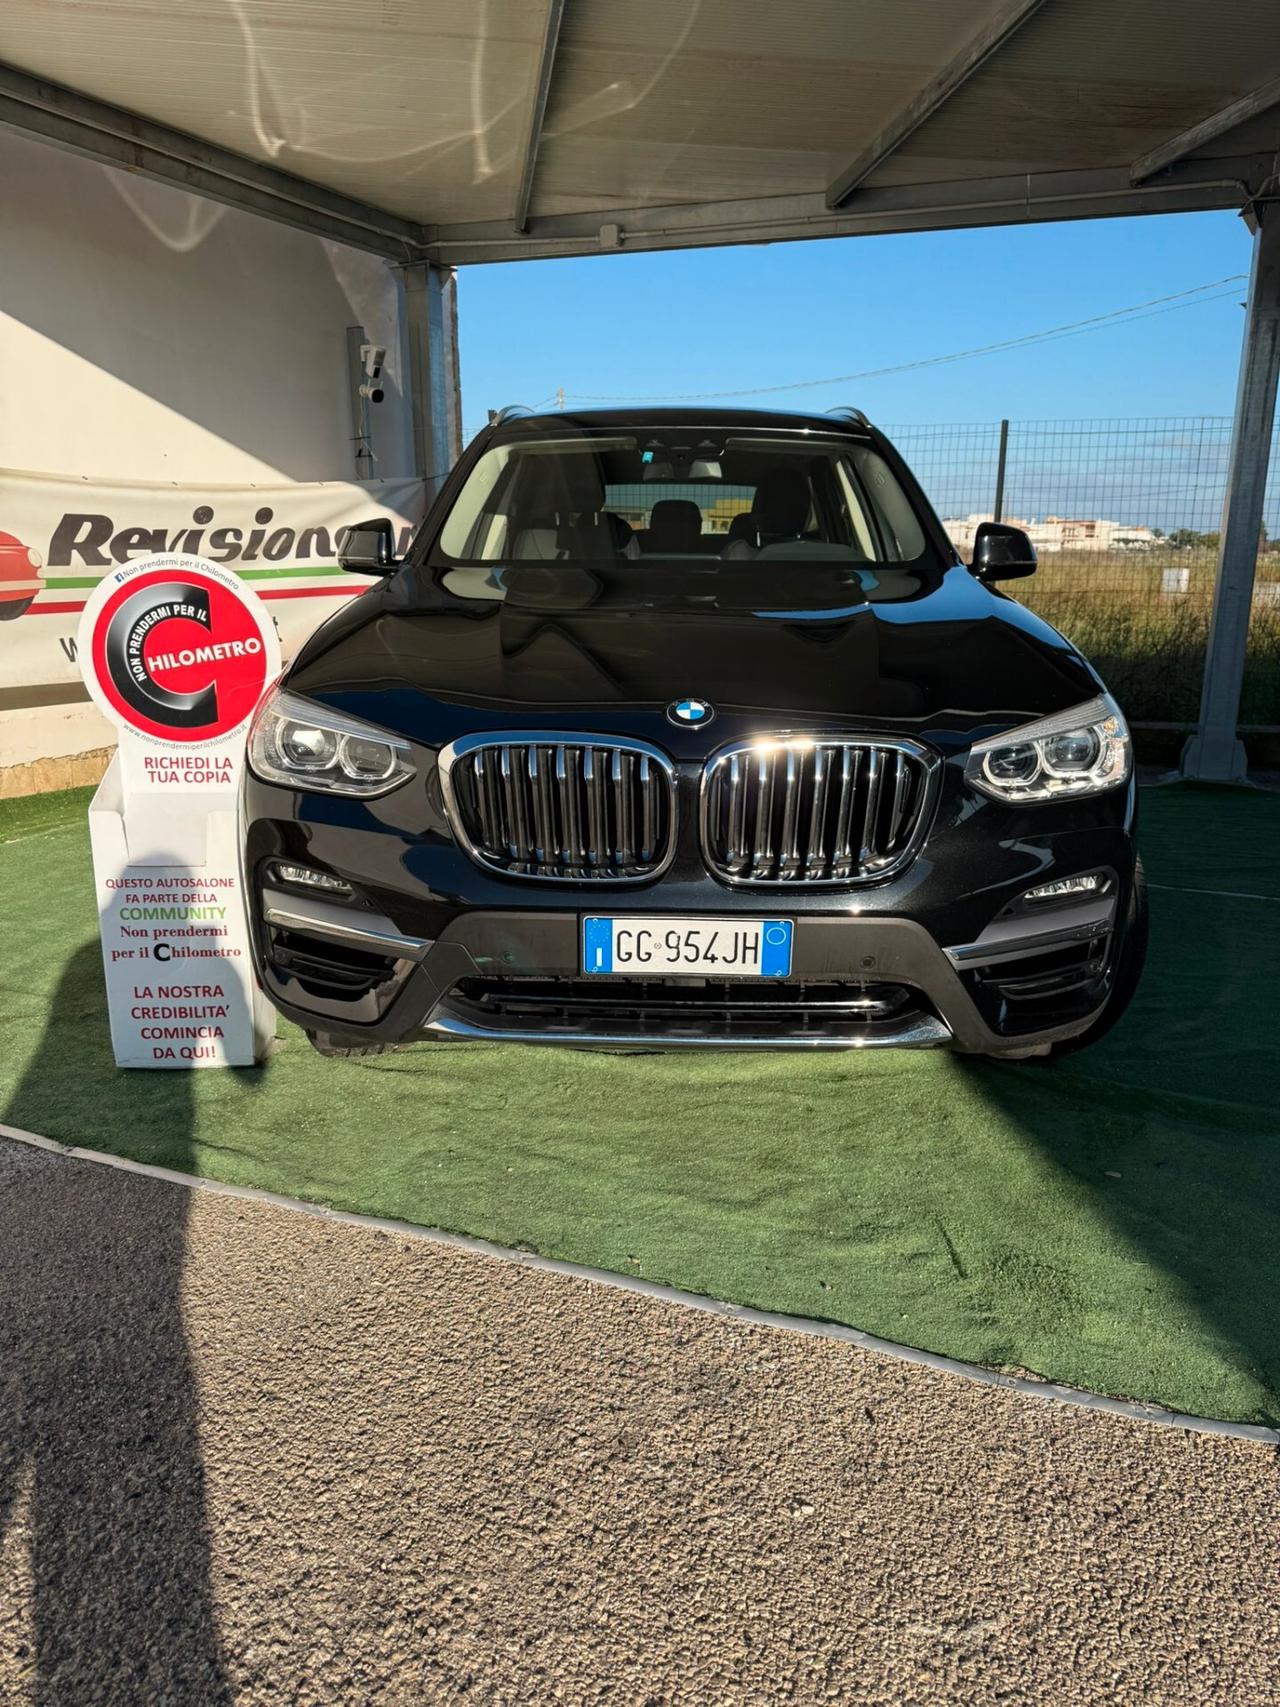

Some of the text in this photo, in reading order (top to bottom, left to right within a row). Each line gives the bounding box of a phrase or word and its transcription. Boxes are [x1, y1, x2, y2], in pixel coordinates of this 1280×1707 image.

[123, 568, 139, 578] Non
[139, 558, 179, 571] prendermi
[180, 560, 193, 568] per
[200, 563, 240, 590] Chilometro
[130, 604, 207, 682] NON PRENDERMI PER IL
[147, 637, 262, 673] HILOMETRO
[144, 757, 234, 770] RICHIEDI LA
[147, 771, 232, 783] TUA COPIA
[105, 878, 235, 889] QUESTO AUTOSALONE
[125, 893, 218, 904] FA PARTE DELLA
[119, 907, 227, 921] COMMUNITY
[120, 925, 228, 941] Non prendermi
[111, 943, 242, 962] per il Chilometro
[616, 930, 759, 964] GG 954JH
[133, 985, 225, 999] LA NOSTRA
[141, 1025, 225, 1040] COMINCIA
[153, 1045, 217, 1060] DA QUI!
